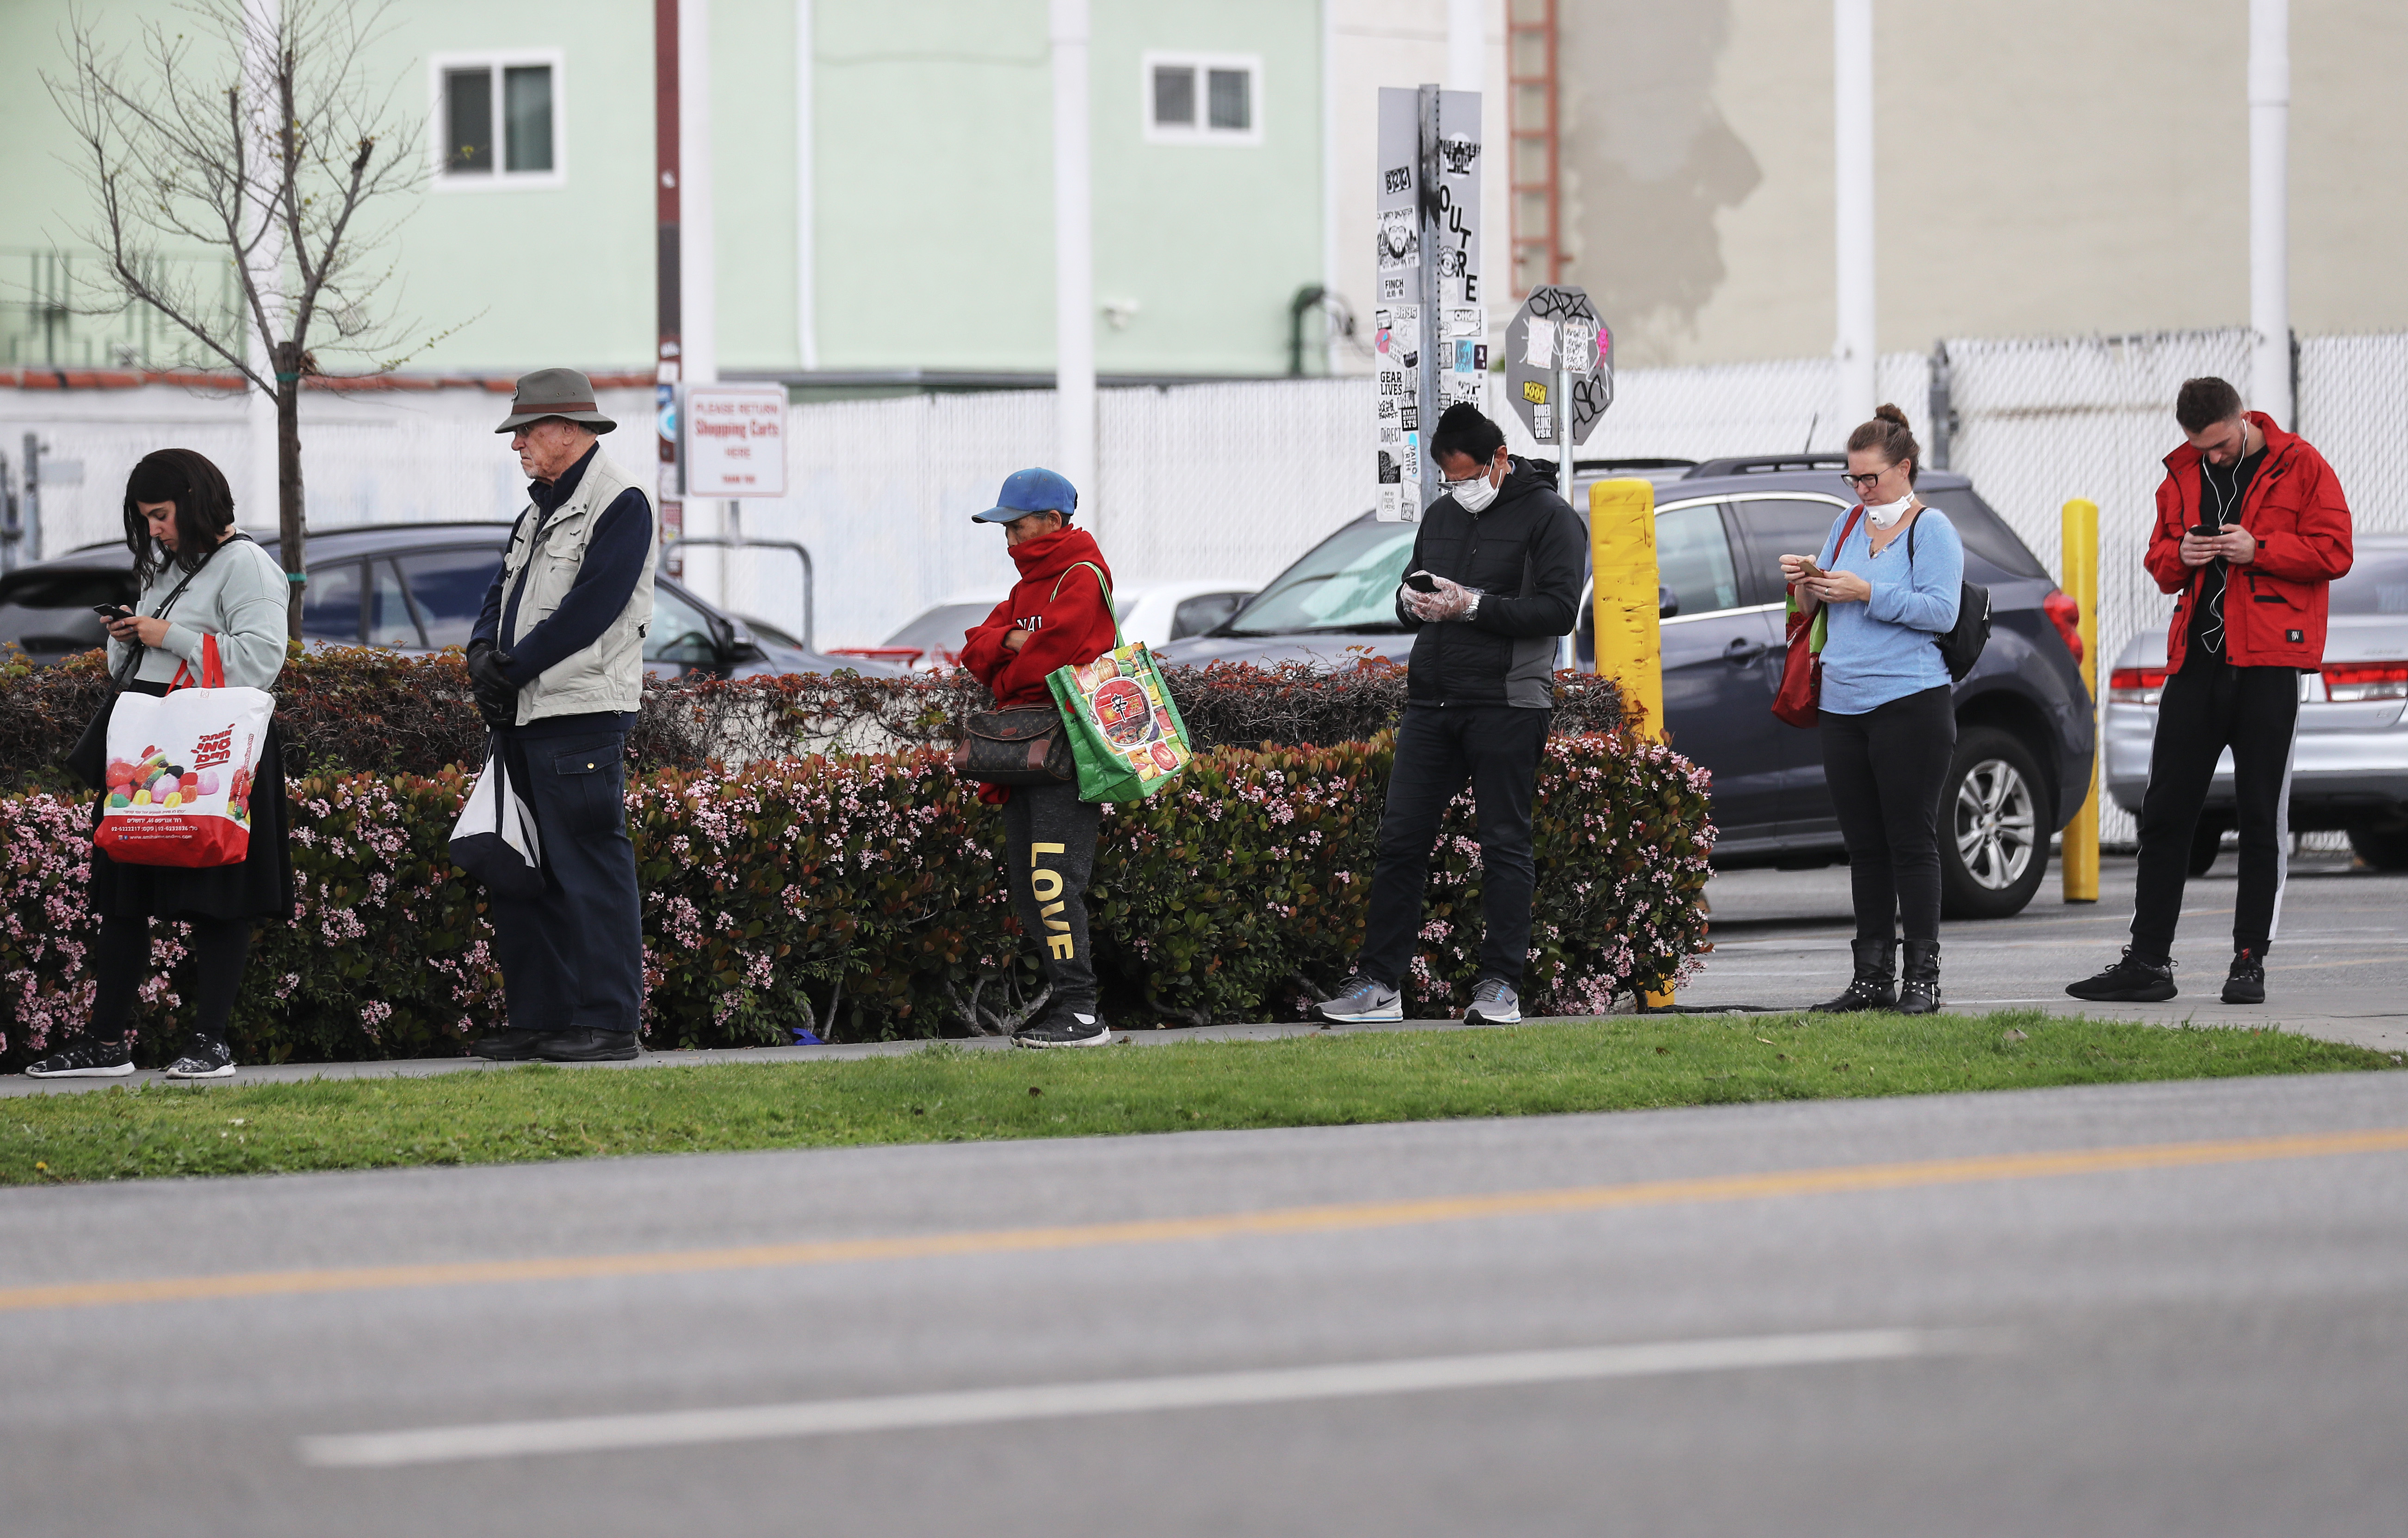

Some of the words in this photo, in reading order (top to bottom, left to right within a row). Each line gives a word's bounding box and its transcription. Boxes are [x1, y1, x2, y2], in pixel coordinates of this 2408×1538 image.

[1386, 278, 1404, 289] FINCH
[1380, 371, 1402, 383] GEAR
[1380, 384, 1402, 395] LIVES
[696, 404, 734, 414] PLEASE
[739, 404, 778, 414] RETURN
[695, 419, 746, 439] Shopping
[750, 419, 779, 436] Carts
[1403, 420, 1417, 428] LTS
[1535, 429, 1552, 438] VSK
[724, 447, 751, 458] HERE
